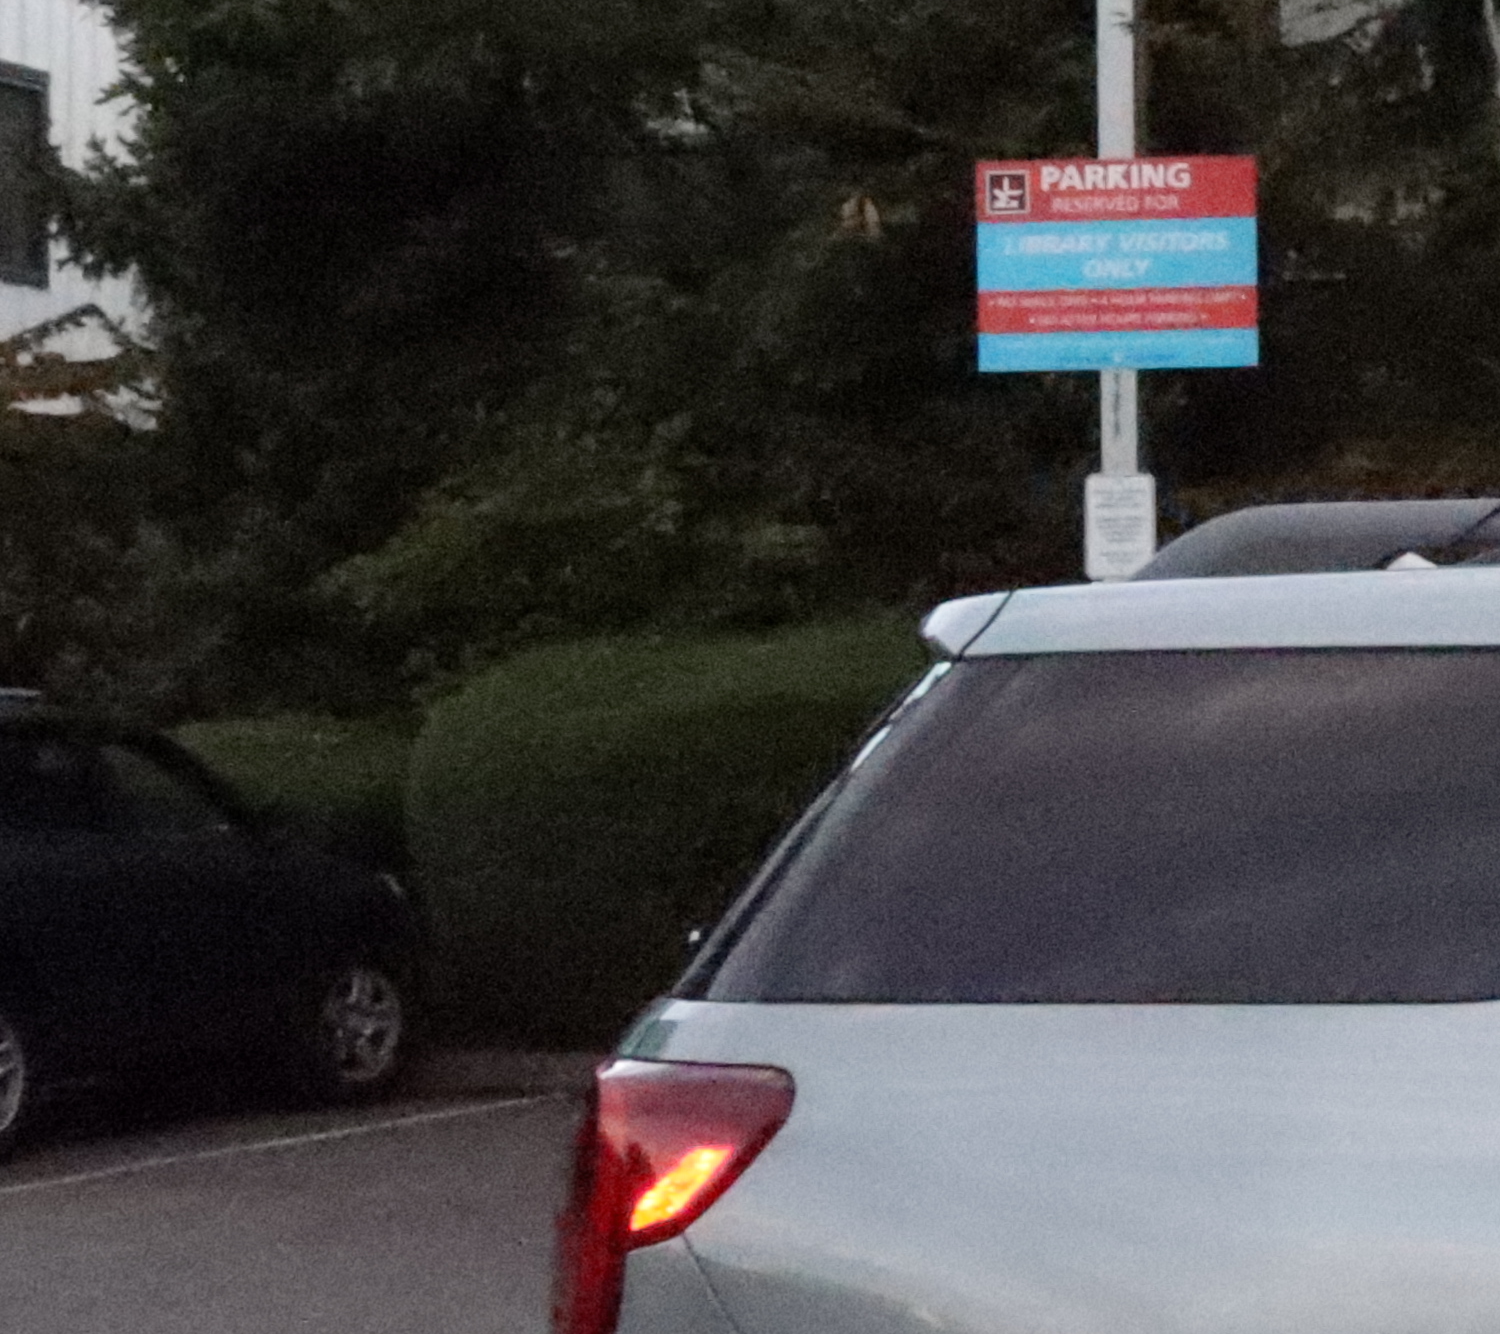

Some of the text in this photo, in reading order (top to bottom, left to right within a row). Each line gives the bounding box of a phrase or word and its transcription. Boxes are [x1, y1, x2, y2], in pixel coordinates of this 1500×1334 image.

[1040, 163, 1192, 191] PARKING
[1051, 195, 1179, 213] RESERVED FOR
[1003, 230, 1229, 255] LIBRARY VISITORS
[1082, 258, 1153, 279] ONLY
